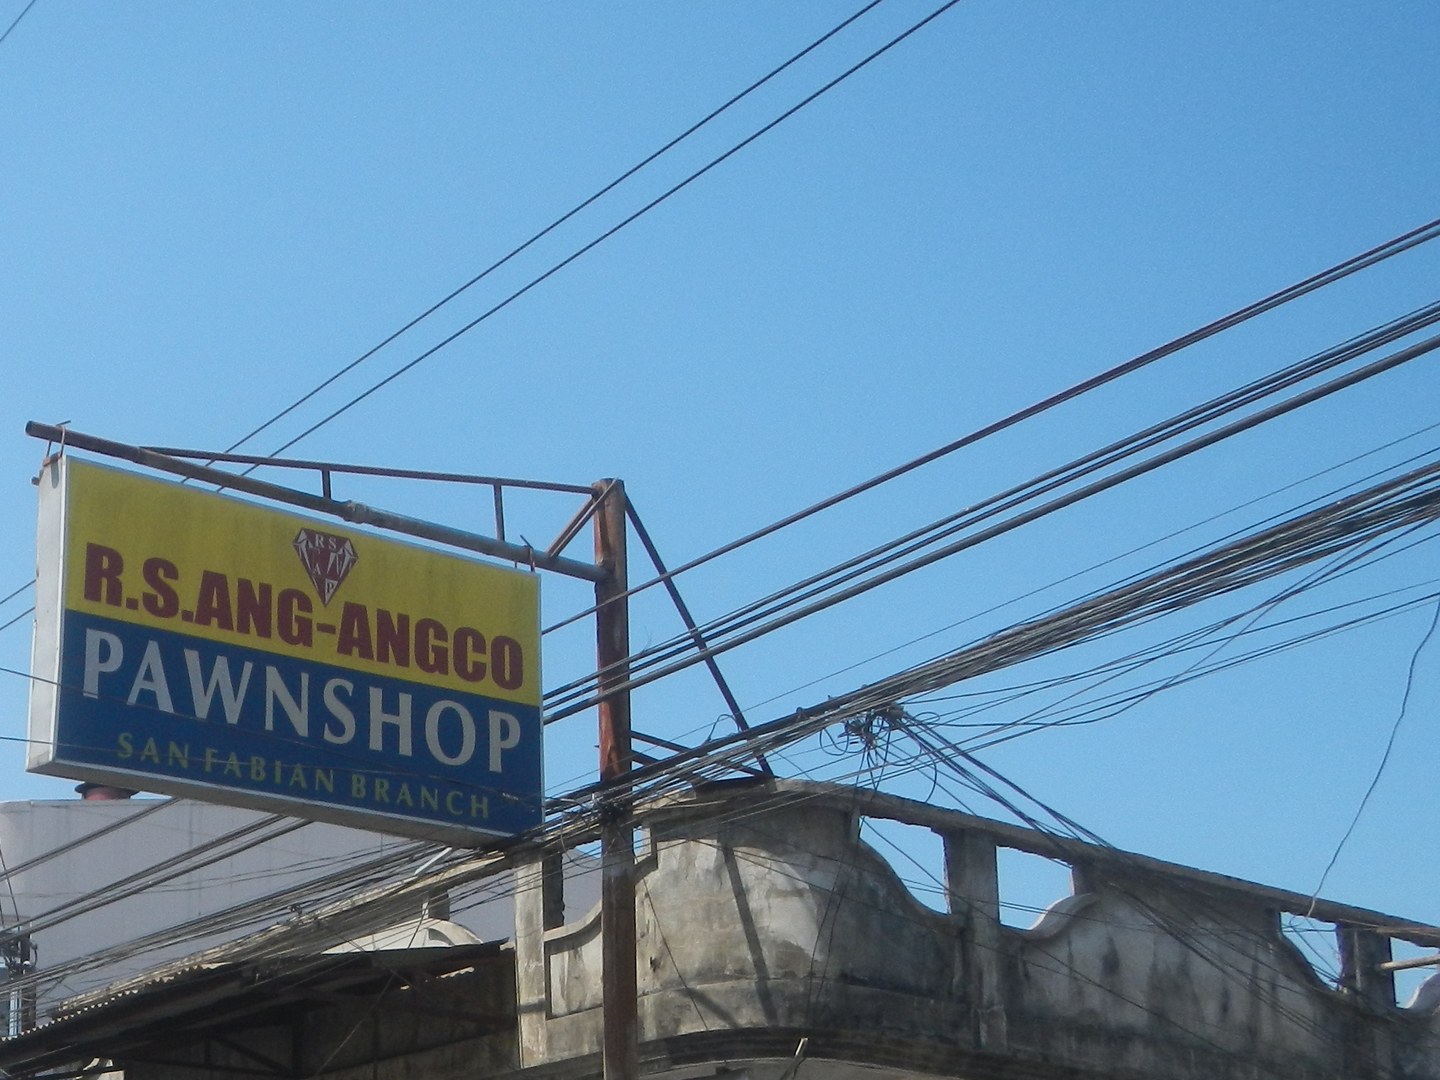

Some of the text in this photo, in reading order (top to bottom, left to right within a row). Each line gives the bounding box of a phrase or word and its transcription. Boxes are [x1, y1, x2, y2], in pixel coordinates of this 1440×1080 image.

[84, 542, 525, 692] R.S.ANG-ANGCO
[82, 628, 522, 774] PAWNSHOP
[117, 733, 490, 820] SAN FABIAN BRANCH
